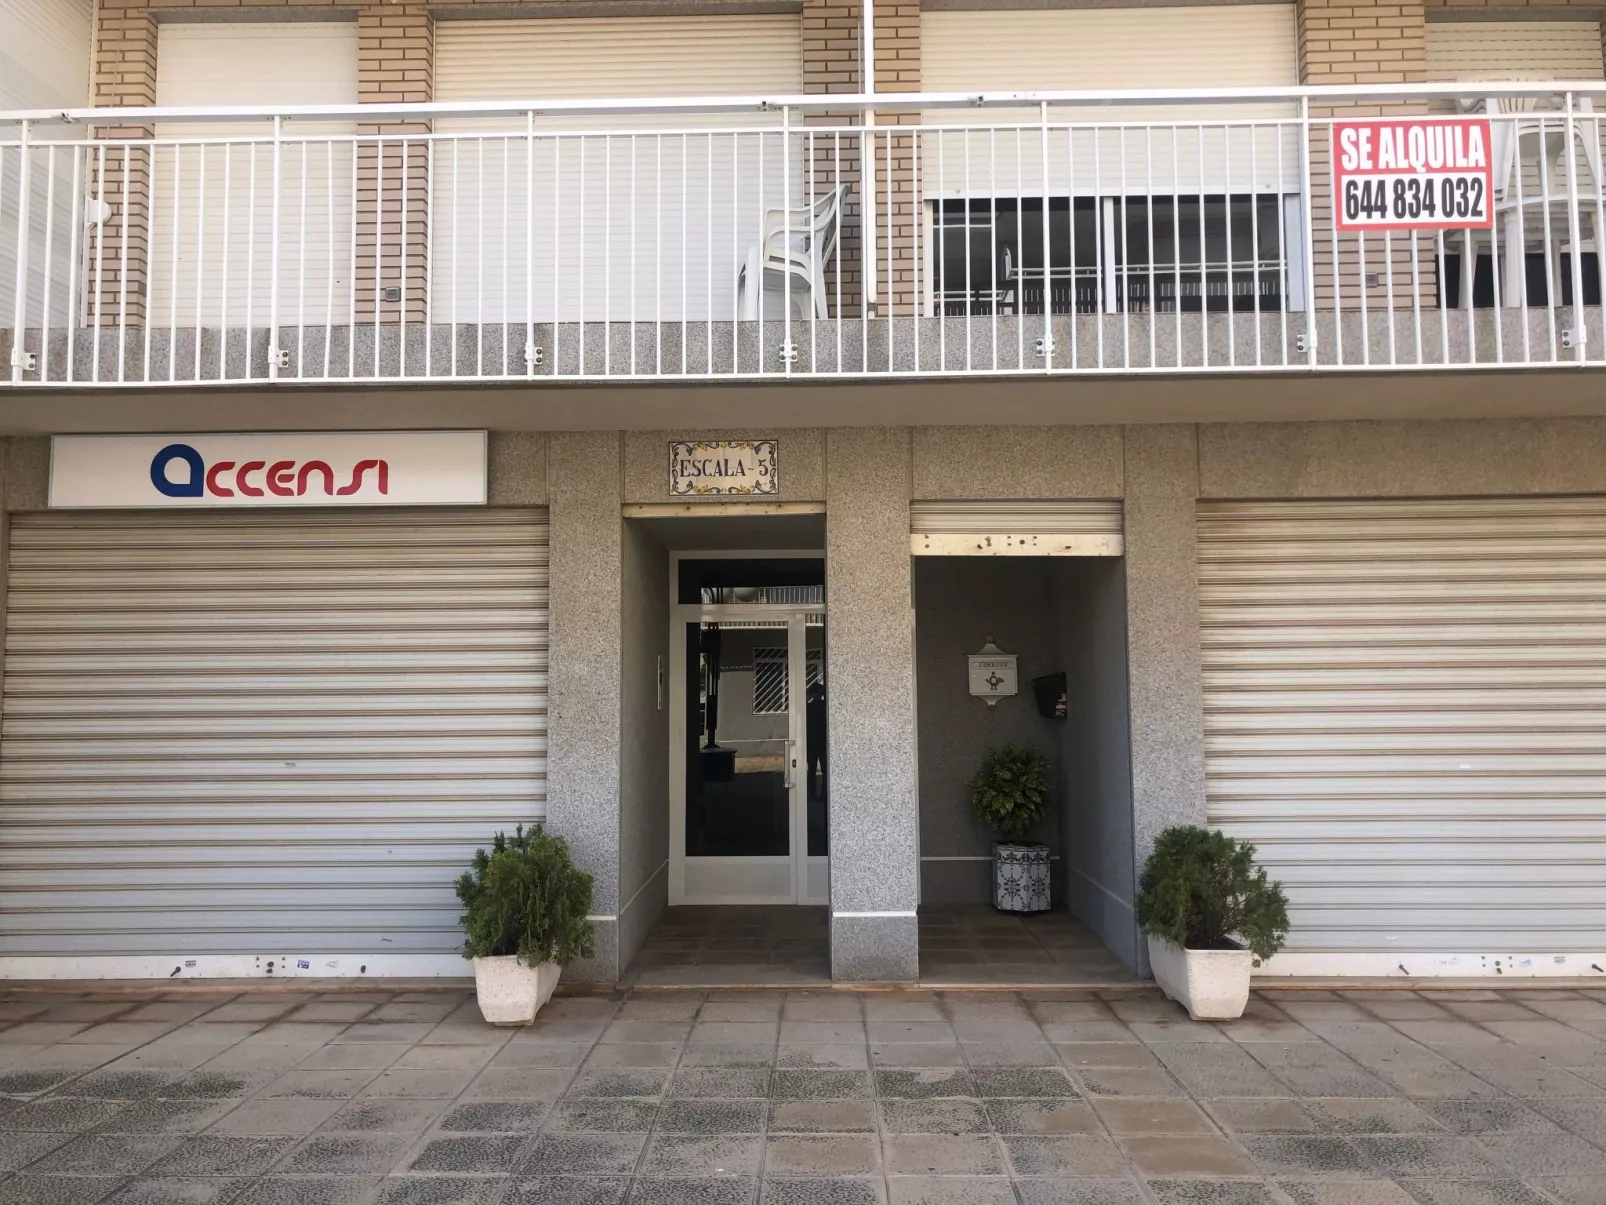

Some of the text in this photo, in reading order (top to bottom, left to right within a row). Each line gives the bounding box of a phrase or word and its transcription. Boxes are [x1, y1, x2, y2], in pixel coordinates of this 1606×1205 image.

[1340, 125, 1486, 173] SE ALQUILA
[1345, 177, 1483, 220] 644 834 032
[680, 458, 746, 478] ESCALA
[758, 458, 769, 477] 5
